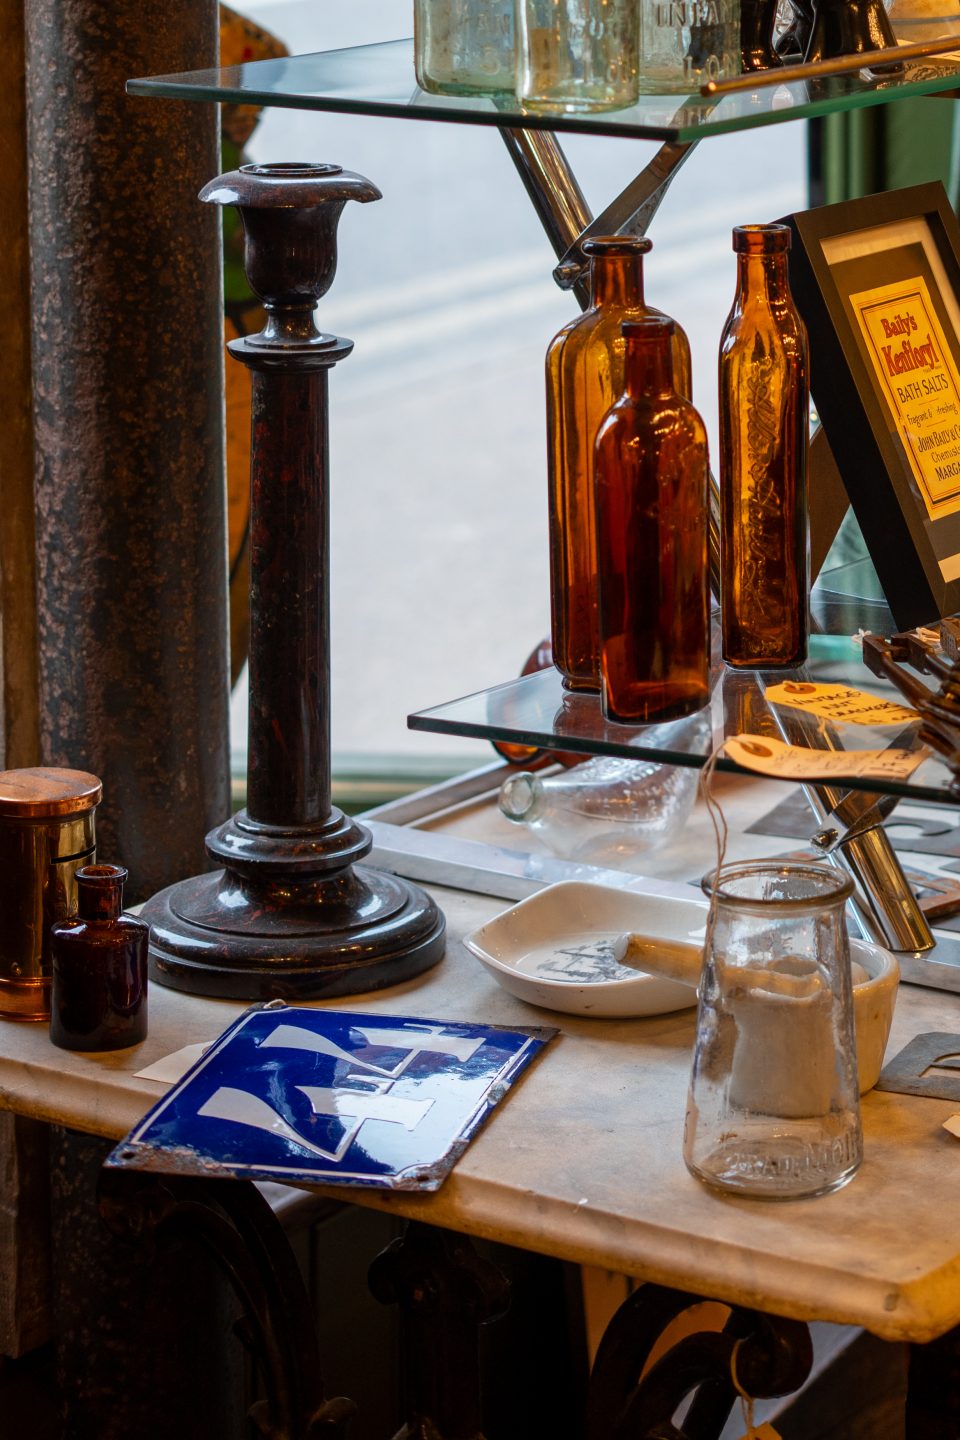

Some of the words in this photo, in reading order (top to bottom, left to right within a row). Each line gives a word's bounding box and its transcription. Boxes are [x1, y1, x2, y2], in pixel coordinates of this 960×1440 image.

[880, 311, 918, 339] Baily's
[896, 382, 924, 405] BATH
[922, 373, 949, 396] SALTS
[917, 433, 937, 454] JOHN
